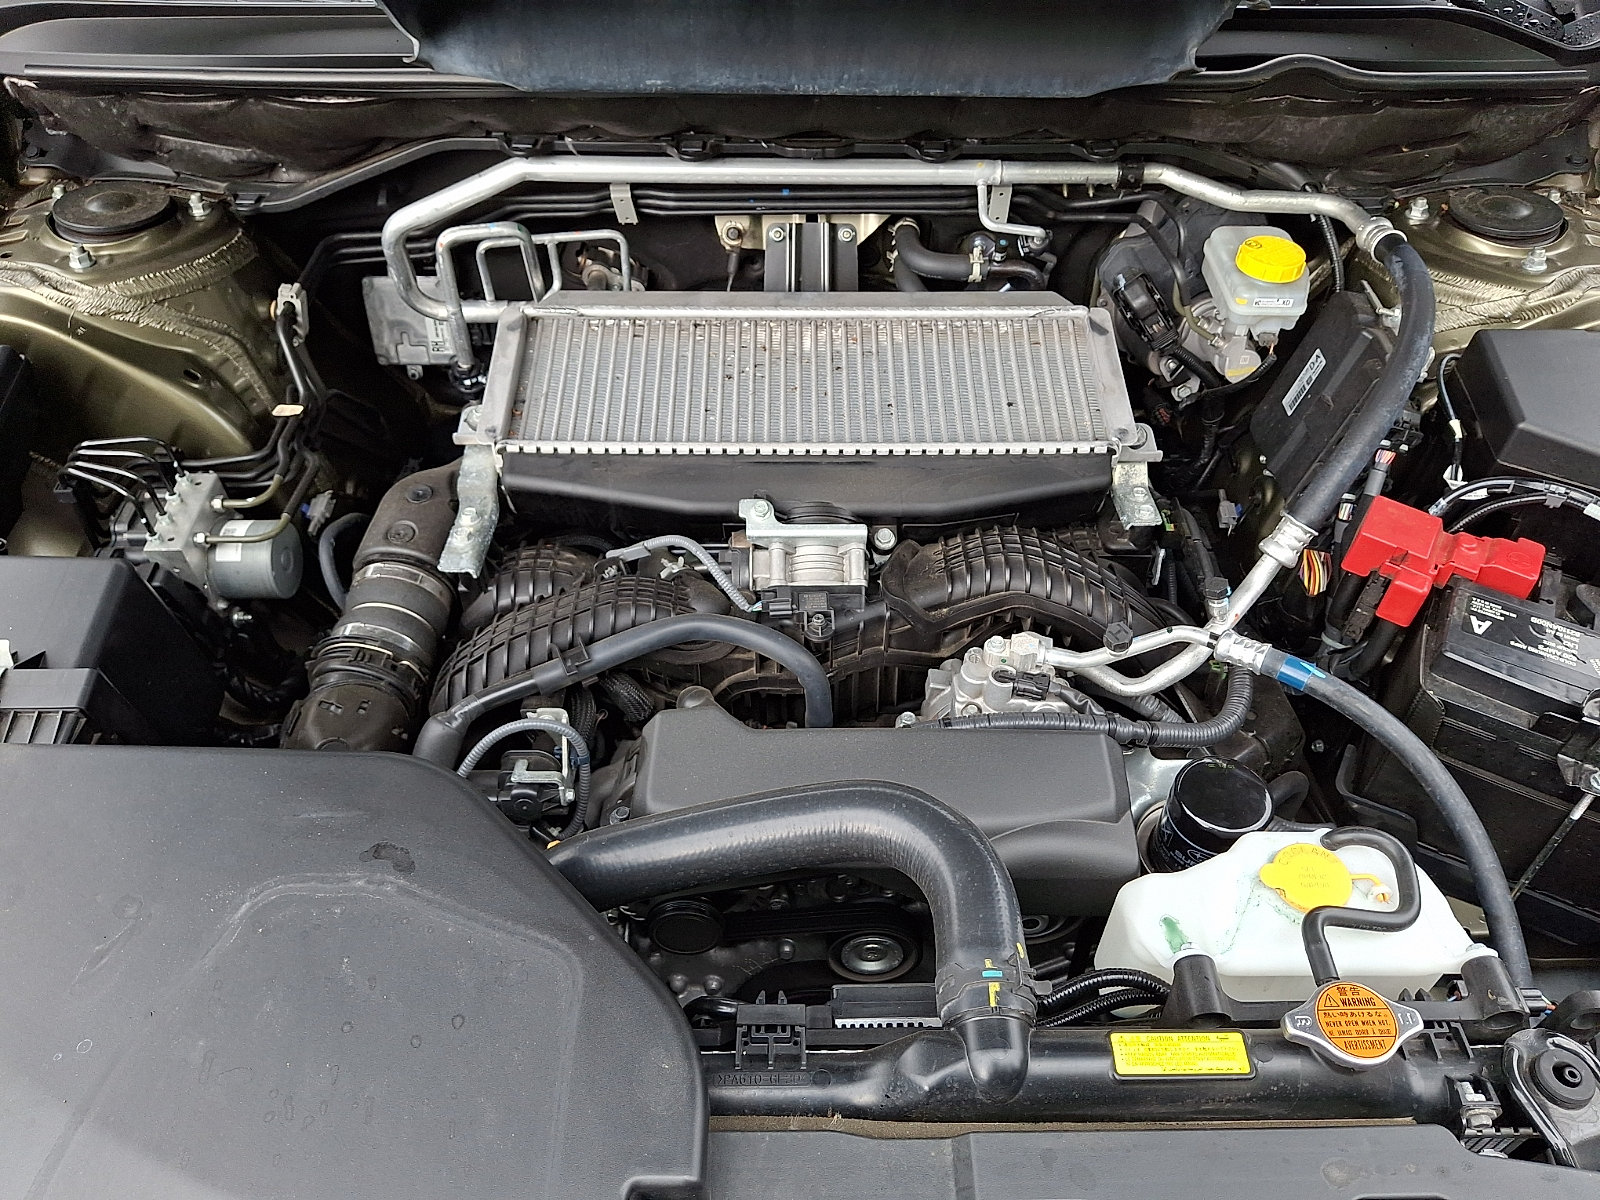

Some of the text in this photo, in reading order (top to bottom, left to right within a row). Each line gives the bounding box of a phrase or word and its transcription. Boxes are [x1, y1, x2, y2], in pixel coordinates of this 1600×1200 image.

[1336, 986, 1361, 996] 警告
[1339, 997, 1376, 1007] WARNING
[1325, 1020, 1343, 1028] NEVER
[1360, 1019, 1376, 1027] WHEN
